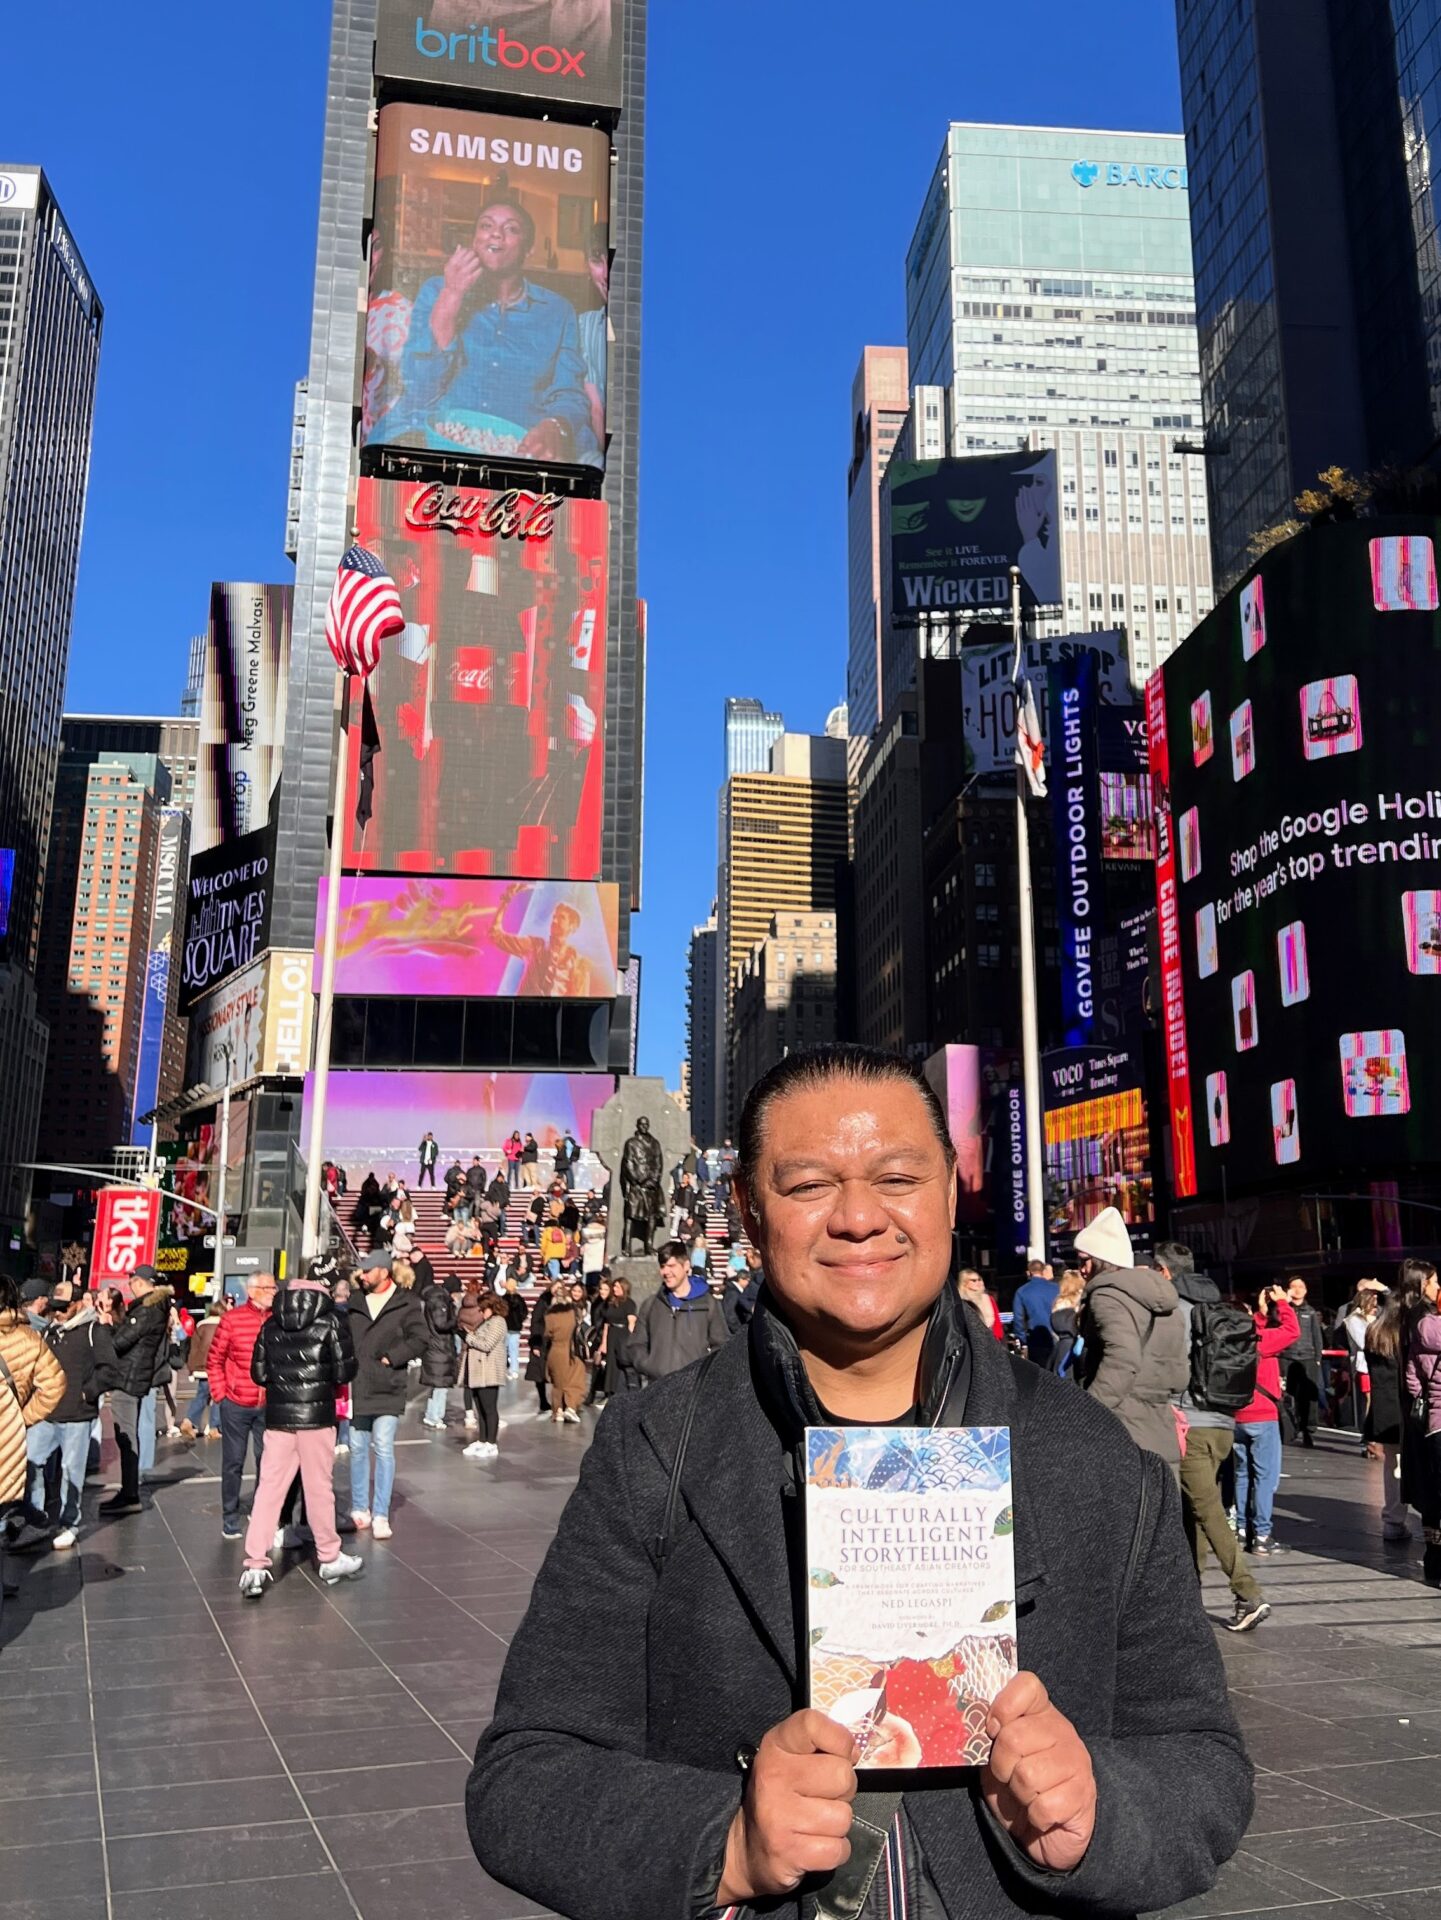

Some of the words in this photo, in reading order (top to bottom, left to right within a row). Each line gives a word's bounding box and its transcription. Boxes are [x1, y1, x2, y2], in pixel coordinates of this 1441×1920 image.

[415, 17, 586, 78] britbox
[409, 128, 583, 173] SAMSUNG
[404, 480, 566, 542] Coca-Cola
[899, 559, 949, 570] Remember
[960, 555, 1008, 566] FOREVER
[955, 545, 980, 555] LIVE
[902, 576, 1009, 607] WICKED
[246, 597, 264, 654] Malvasi
[242, 657, 260, 712] Greene
[979, 642, 1052, 688] LITLE
[240, 718, 259, 751] Meg
[1062, 687, 1083, 778] LIGHTS
[1067, 785, 1091, 917] OUTDOOR
[1230, 844, 1257, 877] Shop
[1259, 830, 1279, 858] the
[1280, 799, 1369, 844] Google
[192, 864, 250, 899] WELCOME
[252, 857, 268, 877] TO
[1105, 862, 1141, 871] KEVANI
[1216, 900, 1232, 924] for
[1233, 886, 1252, 913] the
[1253, 861, 1288, 908] year's
[1289, 852, 1325, 881] top
[220, 889, 266, 930] TIMES
[1160, 879, 1178, 963] COME
[183, 919, 263, 988] SQUARE
[1074, 926, 1093, 1018] GOVEE
[276, 957, 307, 1070] HELLO!
[1166, 968, 1186, 1079] INSIDE!
[1089, 1058, 1107, 1072] Times
[1107, 1052, 1129, 1068] Square
[1009, 1088, 1022, 1164] OUTDOOR
[1014, 1169, 1025, 1222] GOVEE
[107, 1194, 150, 1273] tkts
[840, 1506, 988, 1524] CULTURALLY
[841, 1526, 988, 1544] INTELLIGENT
[839, 1565, 858, 1573] FOR
[859, 1564, 912, 1572] SOUTHEAST
[915, 1563, 942, 1571] ASIAN
[944, 1562, 991, 1570] CREATORS
[840, 1545, 988, 1563] STORYTELLING
[871, 1622, 895, 1630] DAVID
[881, 1600, 905, 1608] NED
[908, 1598, 952, 1608] LEGASPI
